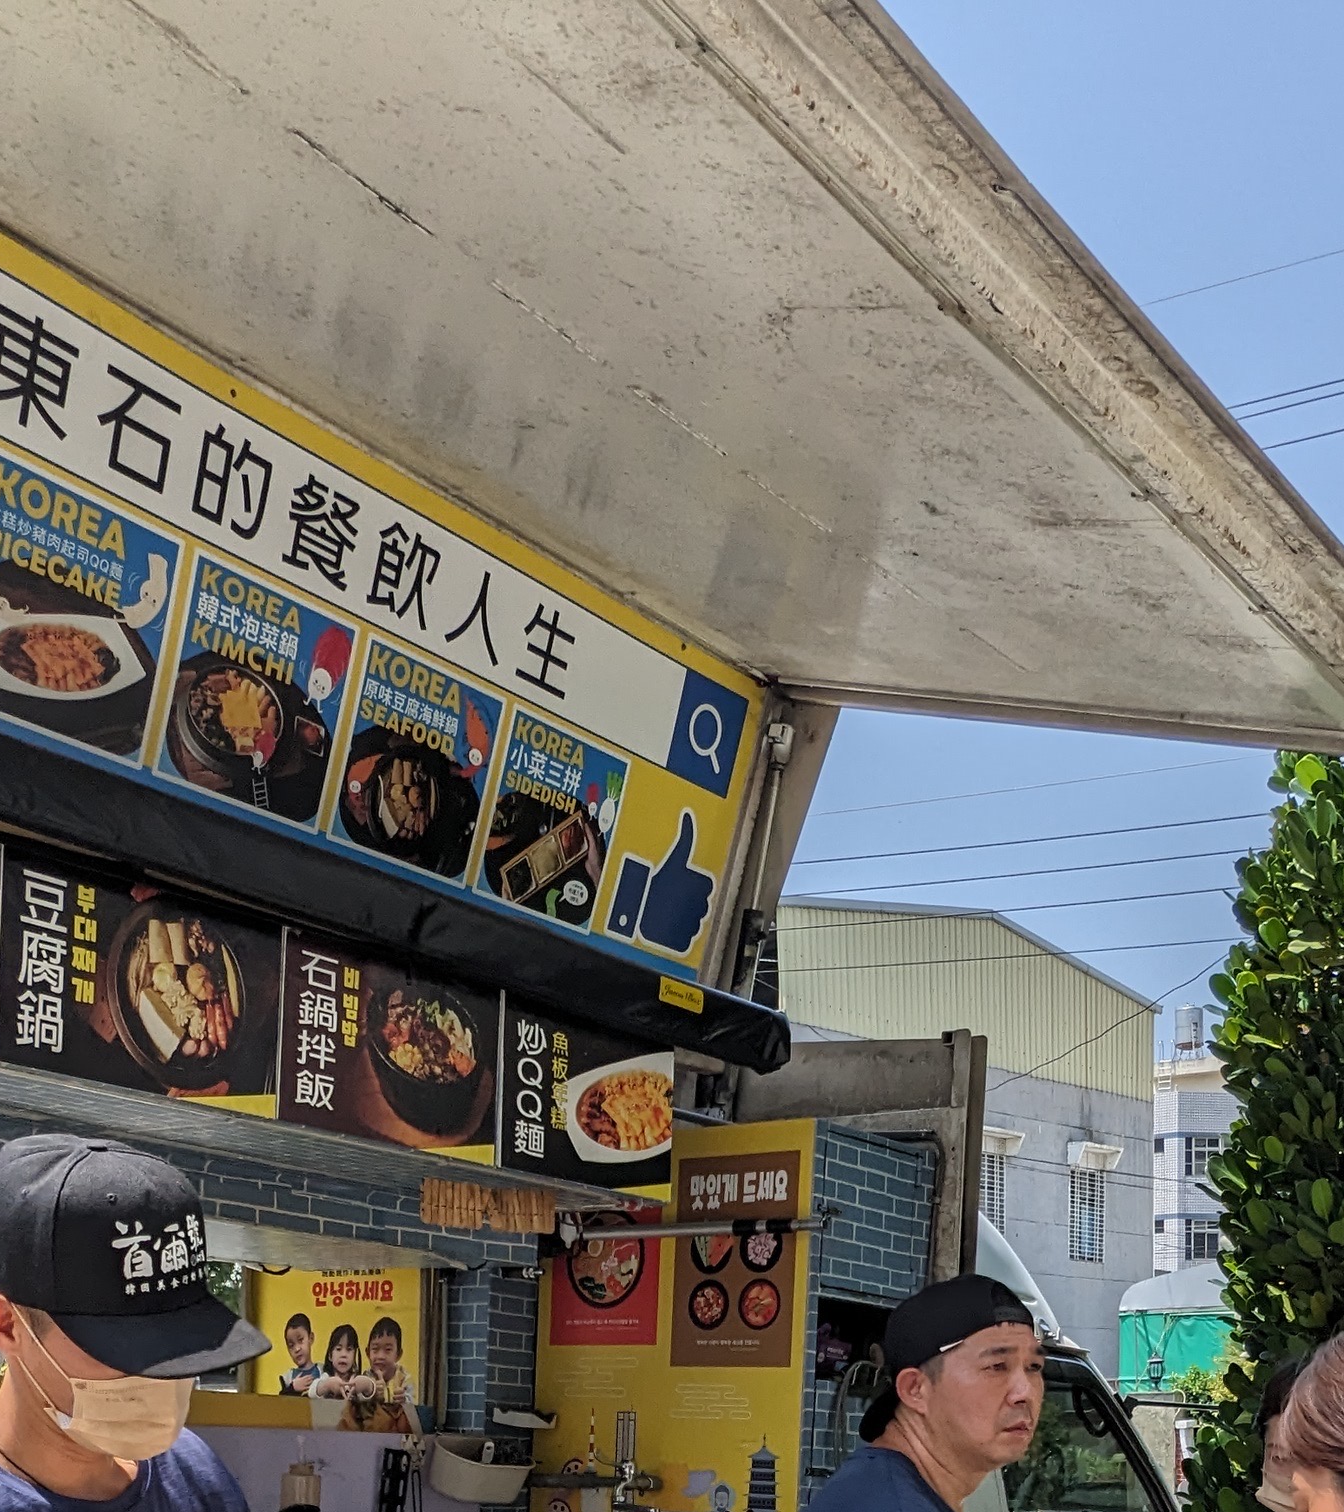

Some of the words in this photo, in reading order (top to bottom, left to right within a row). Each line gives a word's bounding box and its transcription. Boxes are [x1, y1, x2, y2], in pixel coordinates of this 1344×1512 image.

[195, 591, 300, 661] 韓式泡菜鍋
[199, 563, 301, 636] KOREA
[190, 618, 295, 686] KIMCHI
[368, 645, 461, 715] KOREA
[359, 697, 456, 756] SEAFOOD
[363, 677, 459, 739] 原味豆腐海鮮鍋
[510, 743, 583, 797] 小菜三拼
[514, 715, 585, 770] KOREA
[504, 770, 577, 815] SIDEDISH
[15, 868, 68, 1054] 豆腐鍋
[294, 949, 339, 1112] 石鍋拌飯
[341, 965, 361, 1048] 비빔밥
[514, 1018, 548, 1160] 炒QQ麵
[689, 1173, 738, 1211] 맛있게
[742, 1169, 789, 1204] 드세요
[312, 1279, 394, 1307] 안녕하세요
